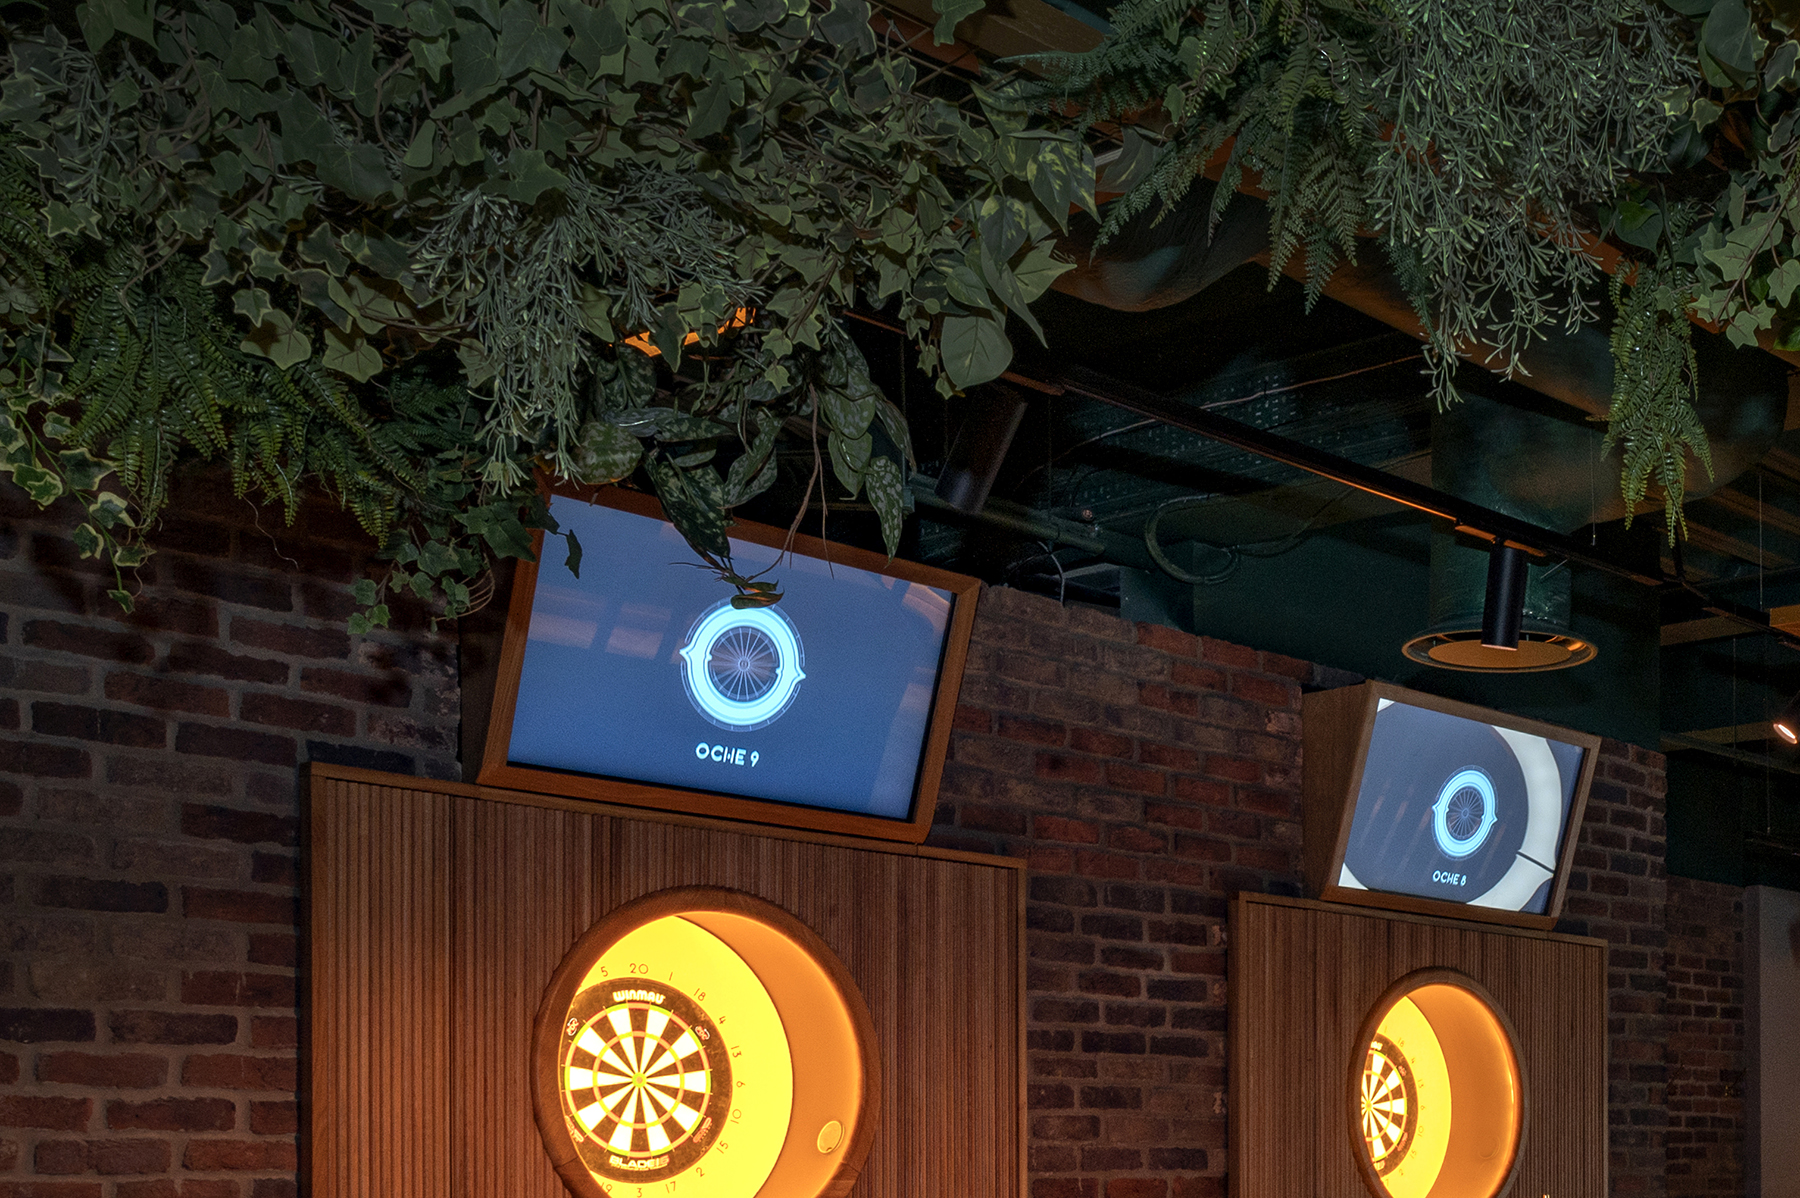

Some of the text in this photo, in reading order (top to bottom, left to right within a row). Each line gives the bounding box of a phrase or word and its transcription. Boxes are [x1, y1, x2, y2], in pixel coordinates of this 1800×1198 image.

[695, 742, 760, 768] OCHE 9
[1432, 869, 1467, 887] OCHE 8
[600, 966, 609, 978] 5
[629, 963, 649, 975] 20
[668, 971, 674, 982] 1
[612, 988, 667, 1006] WINMAU
[693, 987, 707, 1002] 18
[718, 1015, 727, 1025] 4
[730, 1045, 743, 1059] 13
[730, 1108, 743, 1125] 10
[716, 1140, 729, 1155] 15
[695, 1166, 706, 1178] 2
[636, 1187, 643, 1198] 3
[665, 1181, 677, 1194] 17
